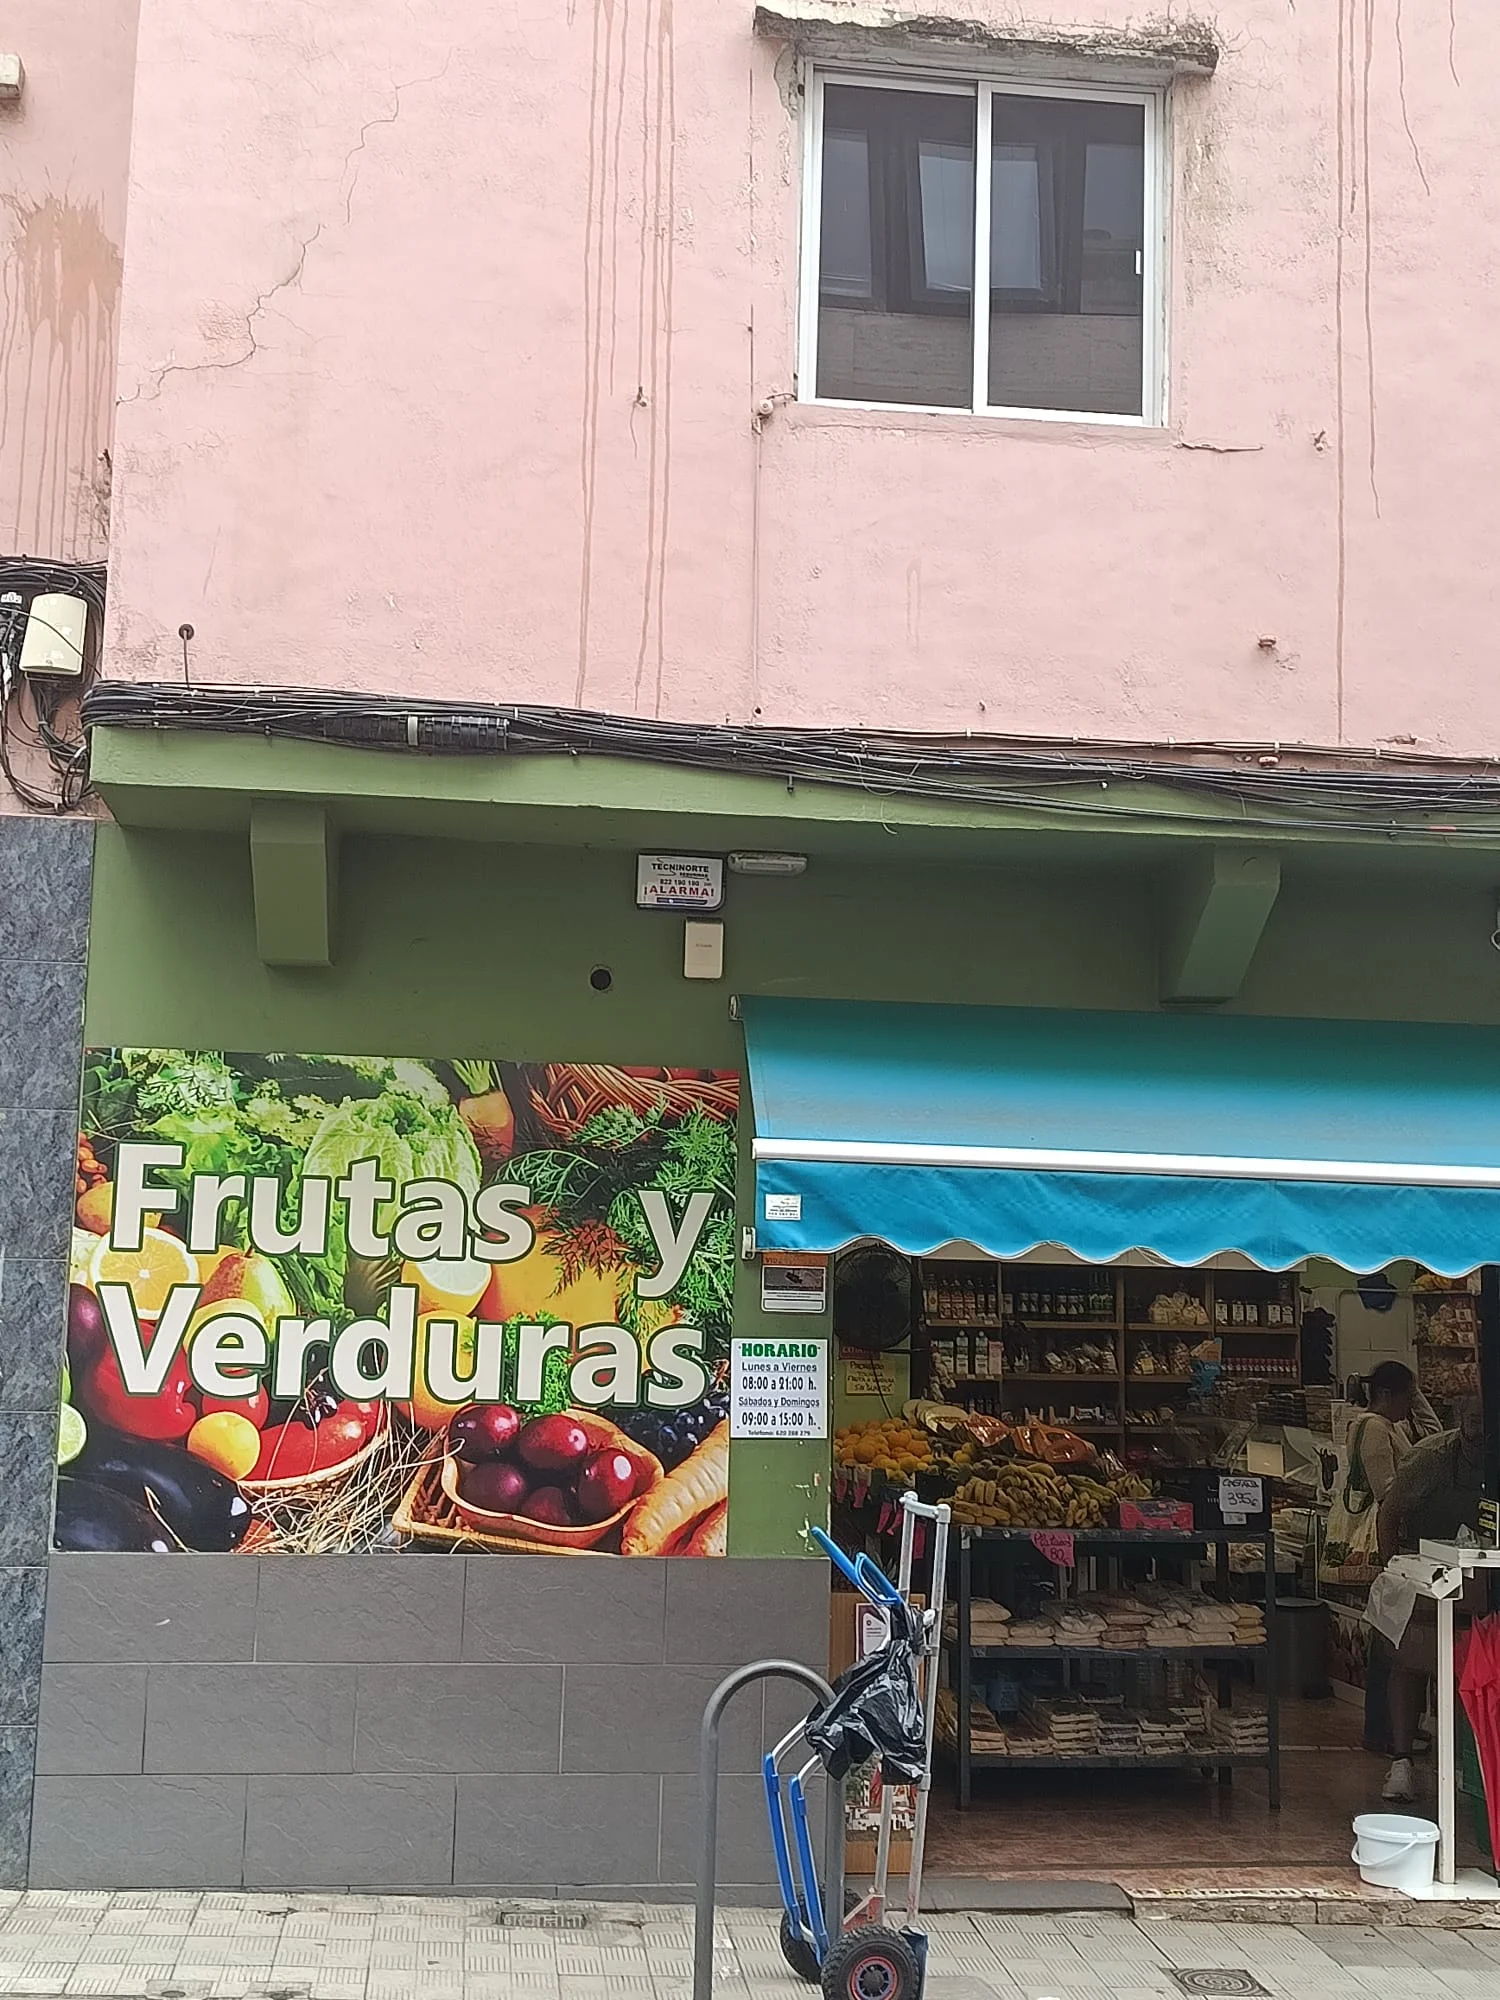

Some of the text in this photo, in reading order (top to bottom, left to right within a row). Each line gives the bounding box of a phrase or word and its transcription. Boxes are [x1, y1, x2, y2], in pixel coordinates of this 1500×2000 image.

[652, 863, 709, 872] TECNINORTE
[644, 885, 714, 896] ¡ALARMA!
[111, 1142, 715, 1299] Frutas y
[98, 1281, 710, 1407] Verduras
[741, 1343, 818, 1358] HORARIO
[741, 1362, 771, 1372] Lunes
[781, 1363, 817, 1373] Viernes
[742, 1376, 817, 1391] 08:00 a 21:00 h.
[774, 1399, 779, 1408] y
[780, 1397, 820, 1409] Domingos
[741, 1412, 817, 1426] 09:00 a 15:00 h.
